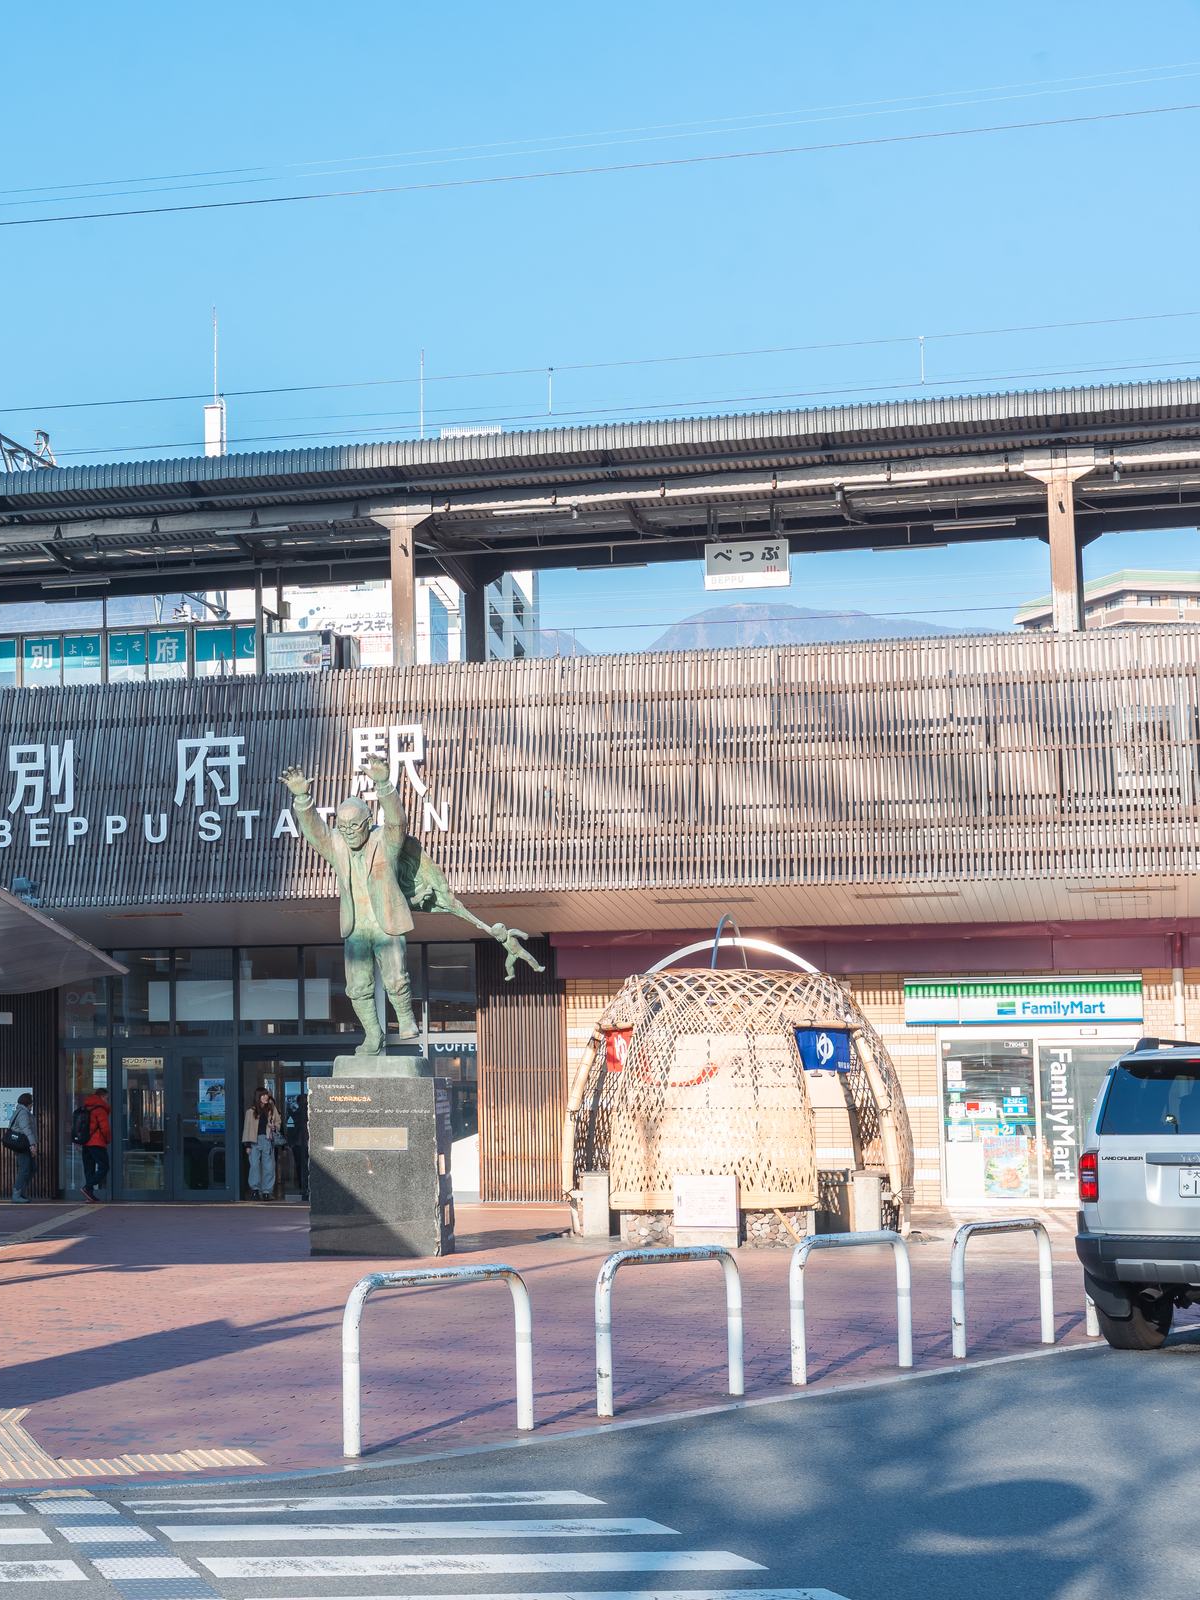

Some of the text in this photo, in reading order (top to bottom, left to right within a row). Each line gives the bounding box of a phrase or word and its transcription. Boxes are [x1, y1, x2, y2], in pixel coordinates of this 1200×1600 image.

[713, 546, 780, 562] べっぷ
[711, 575, 744, 585] BEPPU
[30, 644, 53, 669] 別
[155, 637, 179, 663] 府
[1022, 1000, 1106, 1016] FamilyMart
[434, 1043, 478, 1052] COFFE
[815, 1032, 834, 1065] ゆ
[1046, 1049, 1076, 1181] FamilyMart
